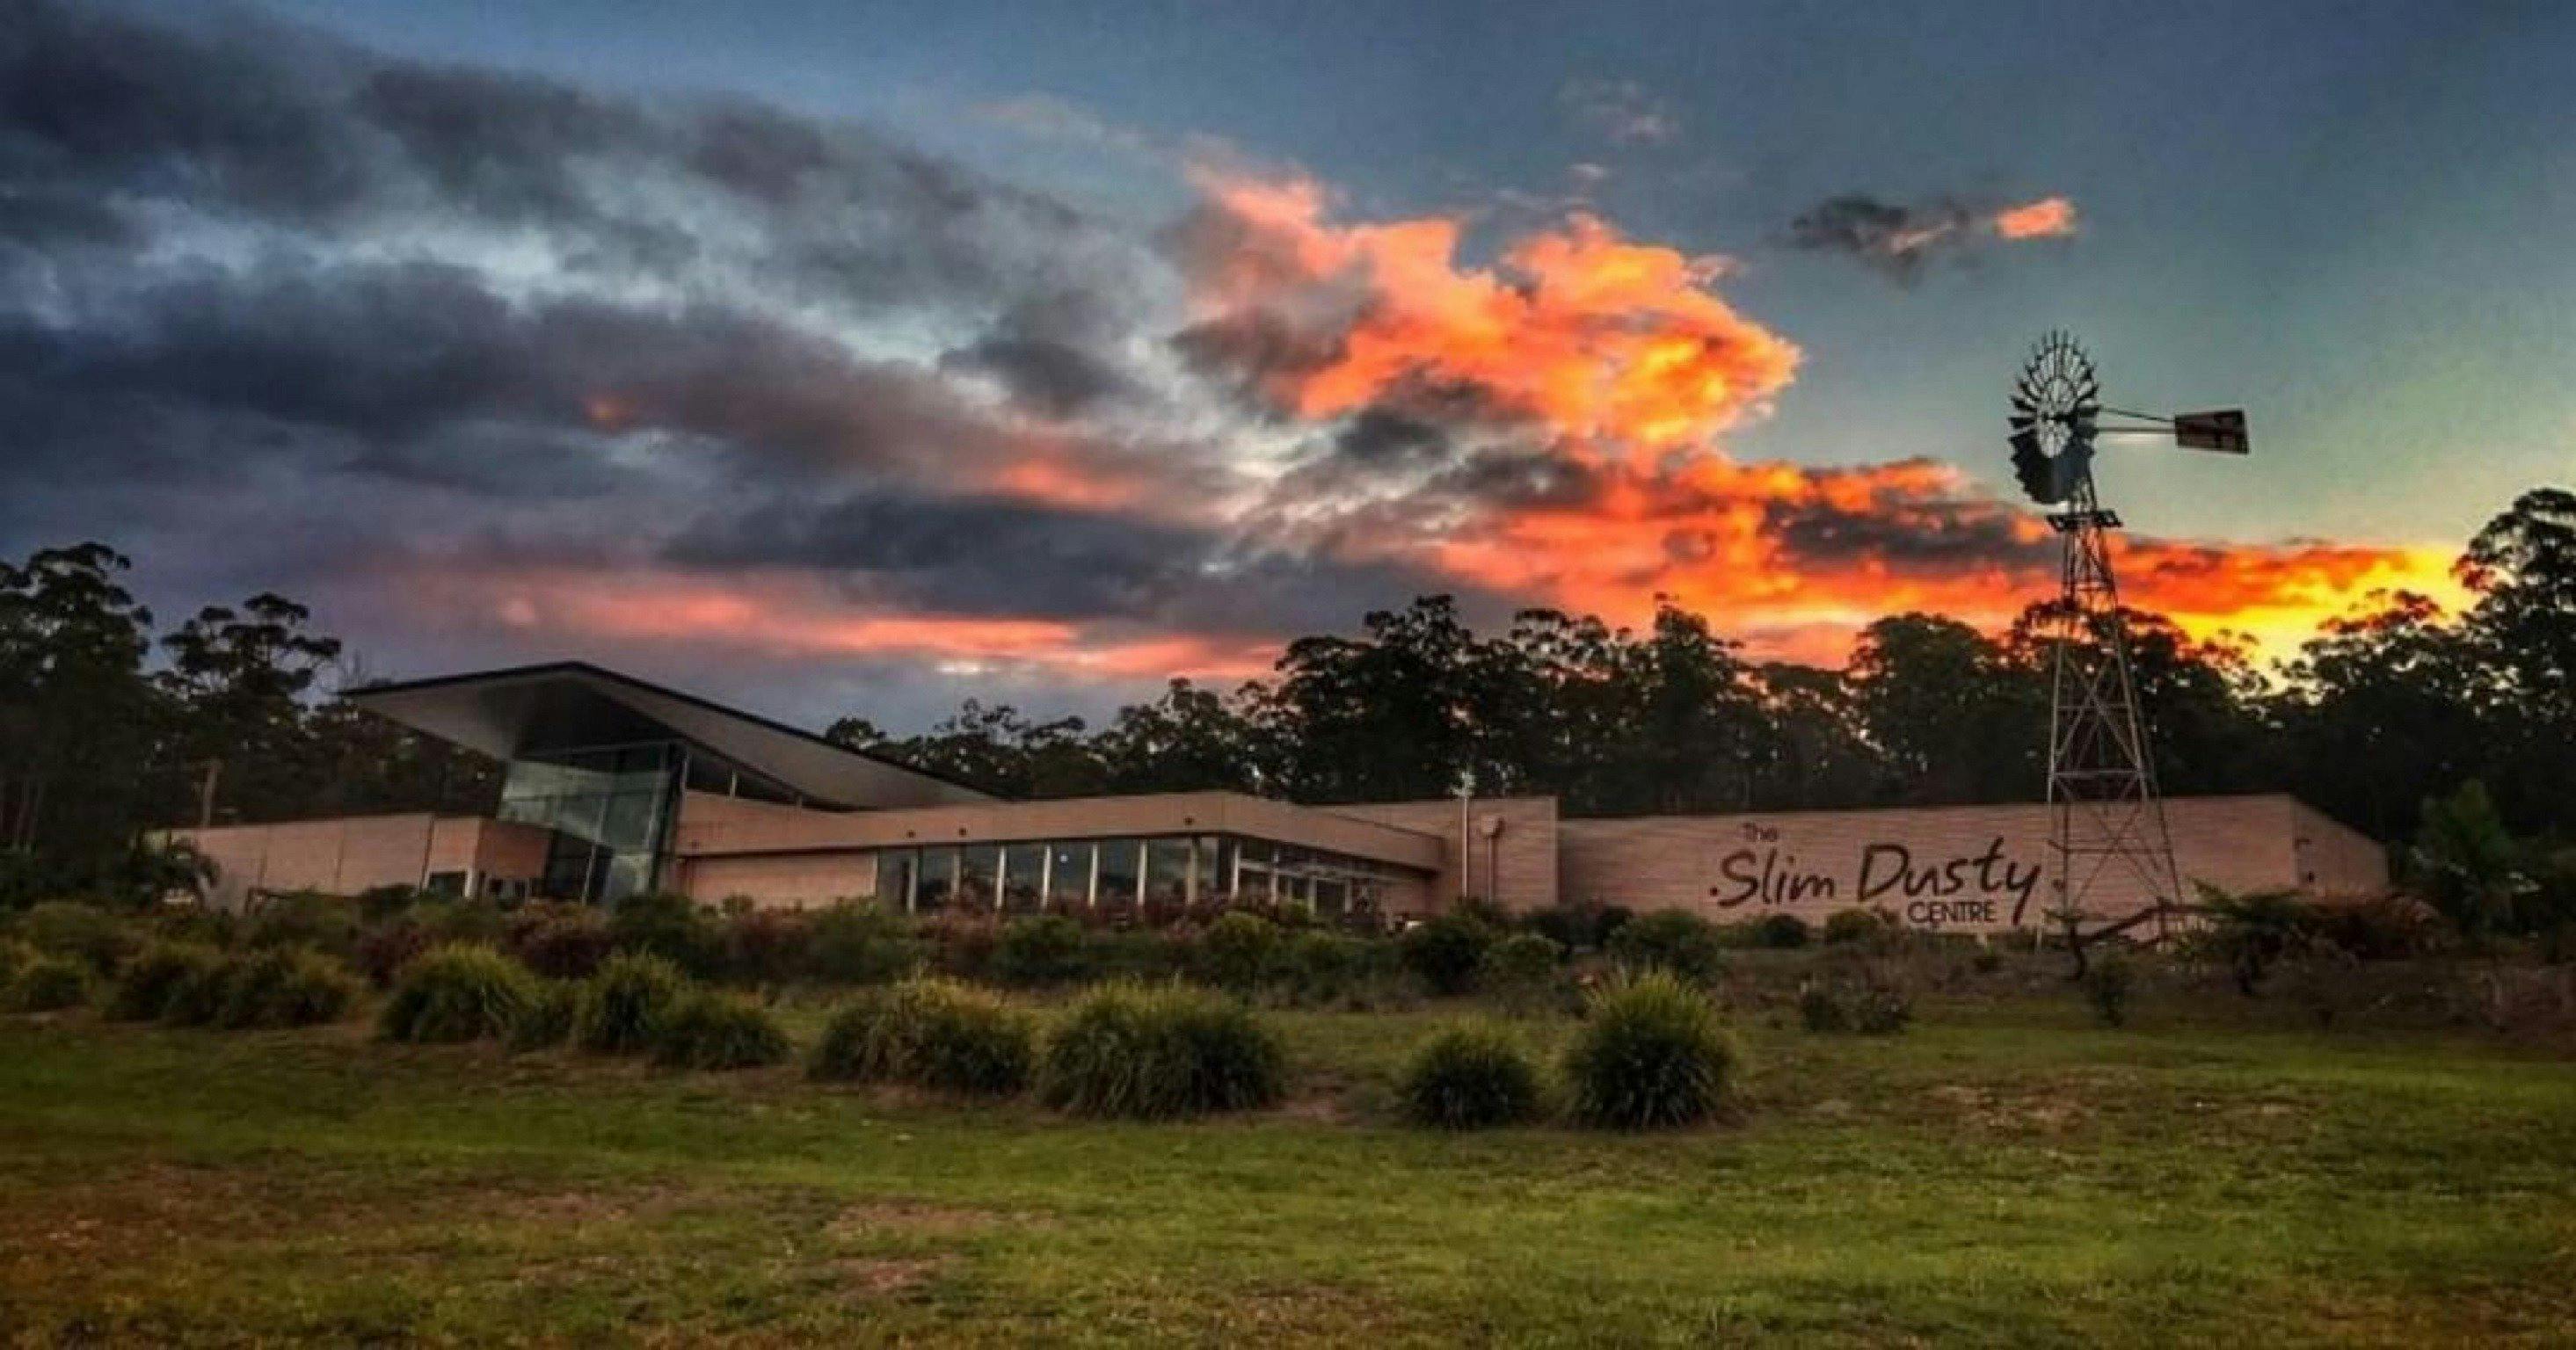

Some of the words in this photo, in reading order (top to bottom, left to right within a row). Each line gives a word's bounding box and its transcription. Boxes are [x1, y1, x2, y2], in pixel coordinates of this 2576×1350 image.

[1743, 823, 1780, 842] The
[1718, 848, 1835, 908] Slim
[1857, 835, 2041, 925] Dusty
[1906, 900, 1996, 924] CENTRE
